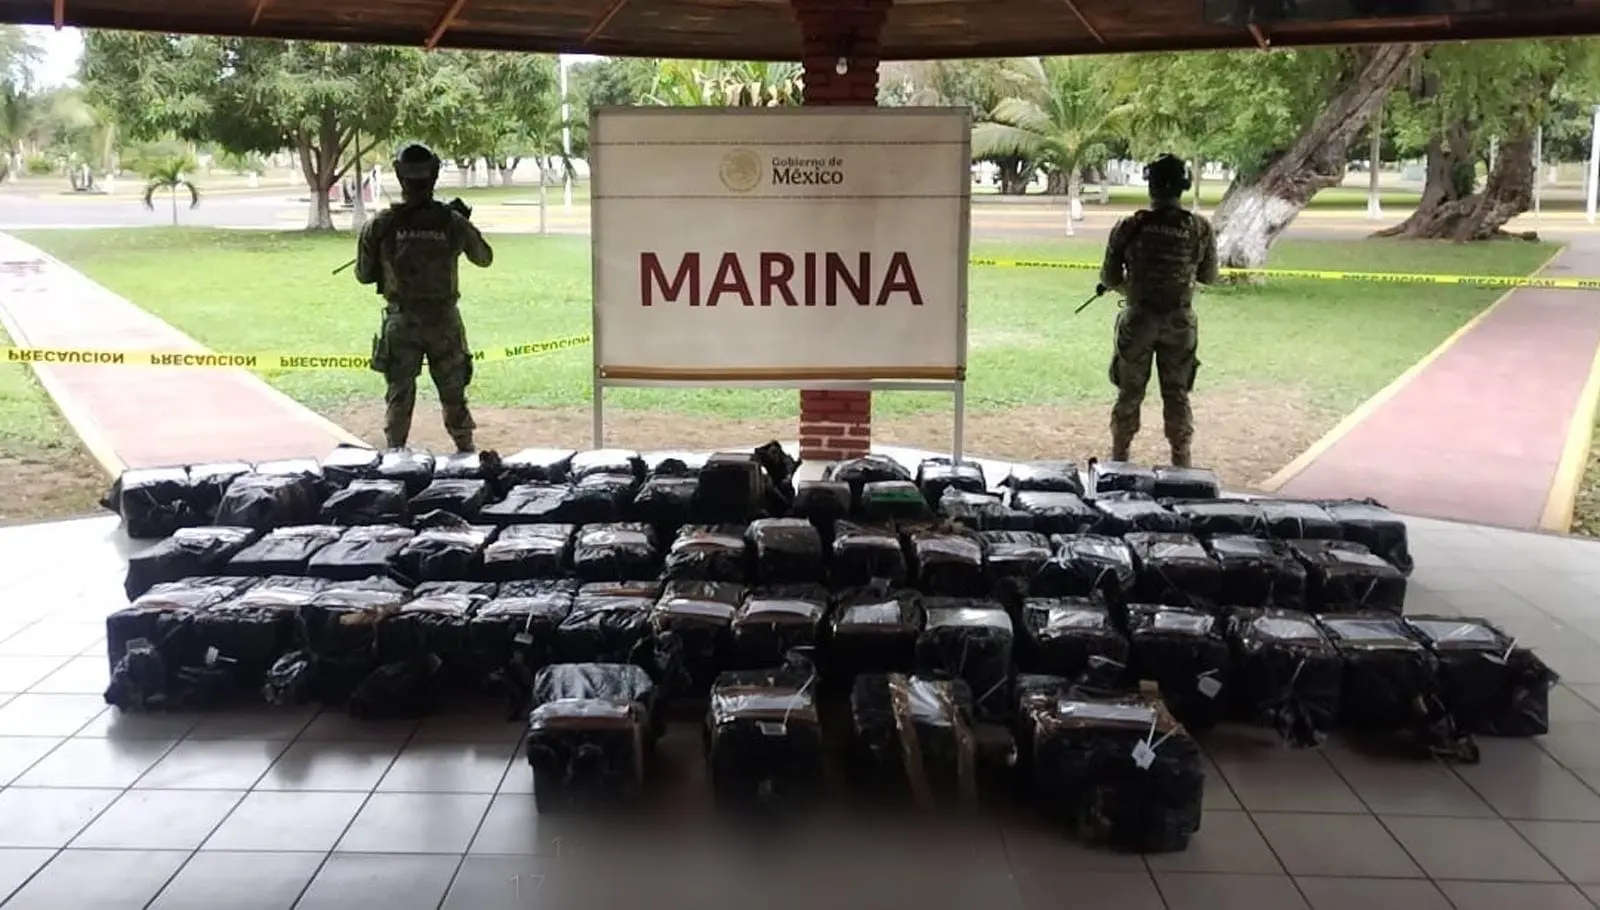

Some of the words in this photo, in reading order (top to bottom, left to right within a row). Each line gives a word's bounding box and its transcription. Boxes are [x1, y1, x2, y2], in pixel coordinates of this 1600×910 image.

[771, 156, 825, 168] Gobierno
[828, 156, 844, 167] de
[771, 167, 844, 185] México
[396, 229, 447, 241] MARINA
[640, 251, 924, 307] MARINA
